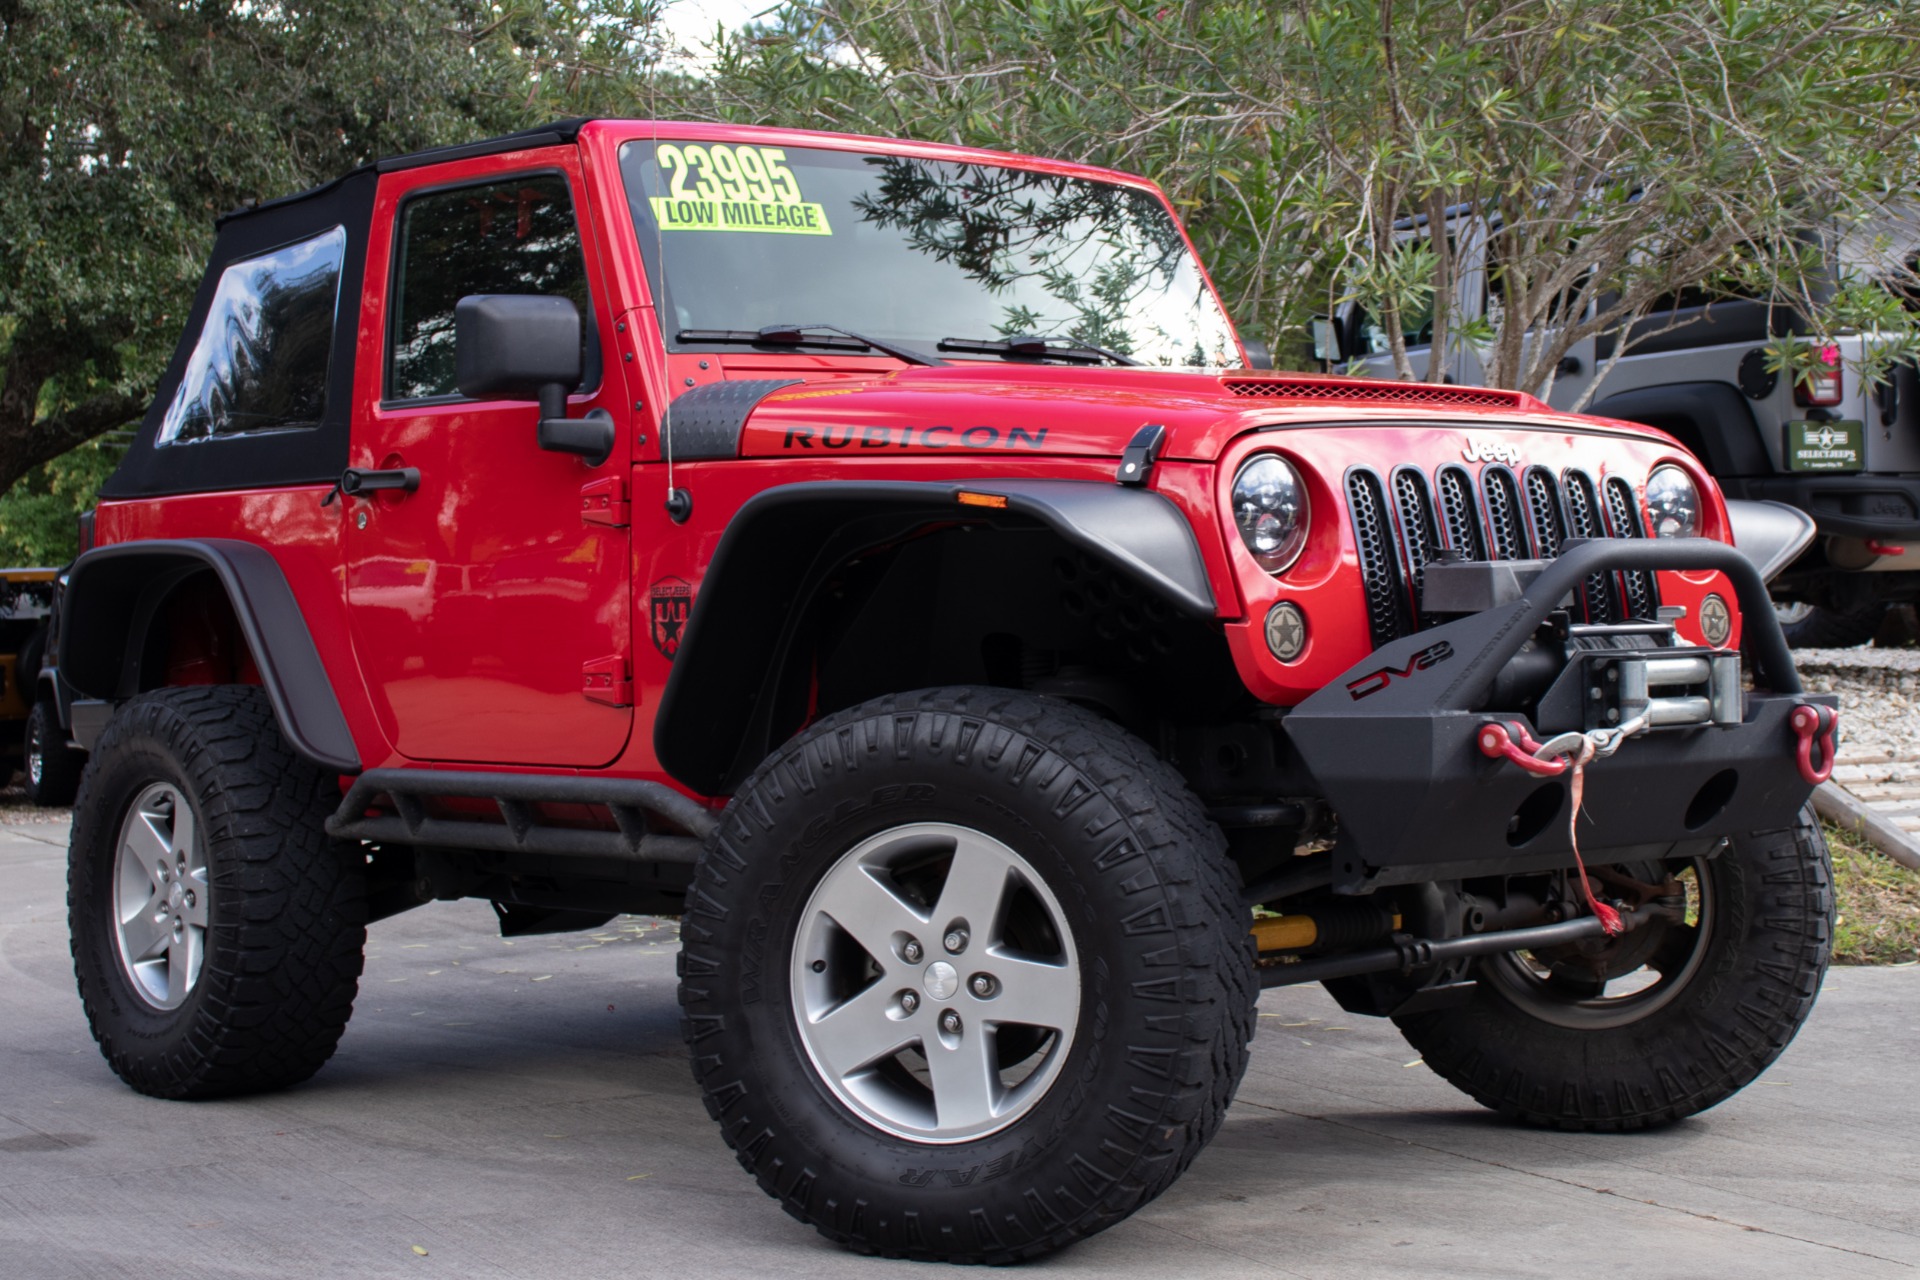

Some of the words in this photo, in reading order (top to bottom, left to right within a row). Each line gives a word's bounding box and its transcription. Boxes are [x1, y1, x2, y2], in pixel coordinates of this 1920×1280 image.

[657, 144, 803, 203] 23995
[665, 200, 716, 225] LOW
[721, 201, 820, 229] MILEAGE
[783, 425, 1049, 450] RUBICON
[1461, 436, 1521, 468] Jeep
[1345, 640, 1455, 702] DV8
[743, 783, 937, 1005] WRANGLER
[899, 956, 1109, 1187] GOODYEAR
